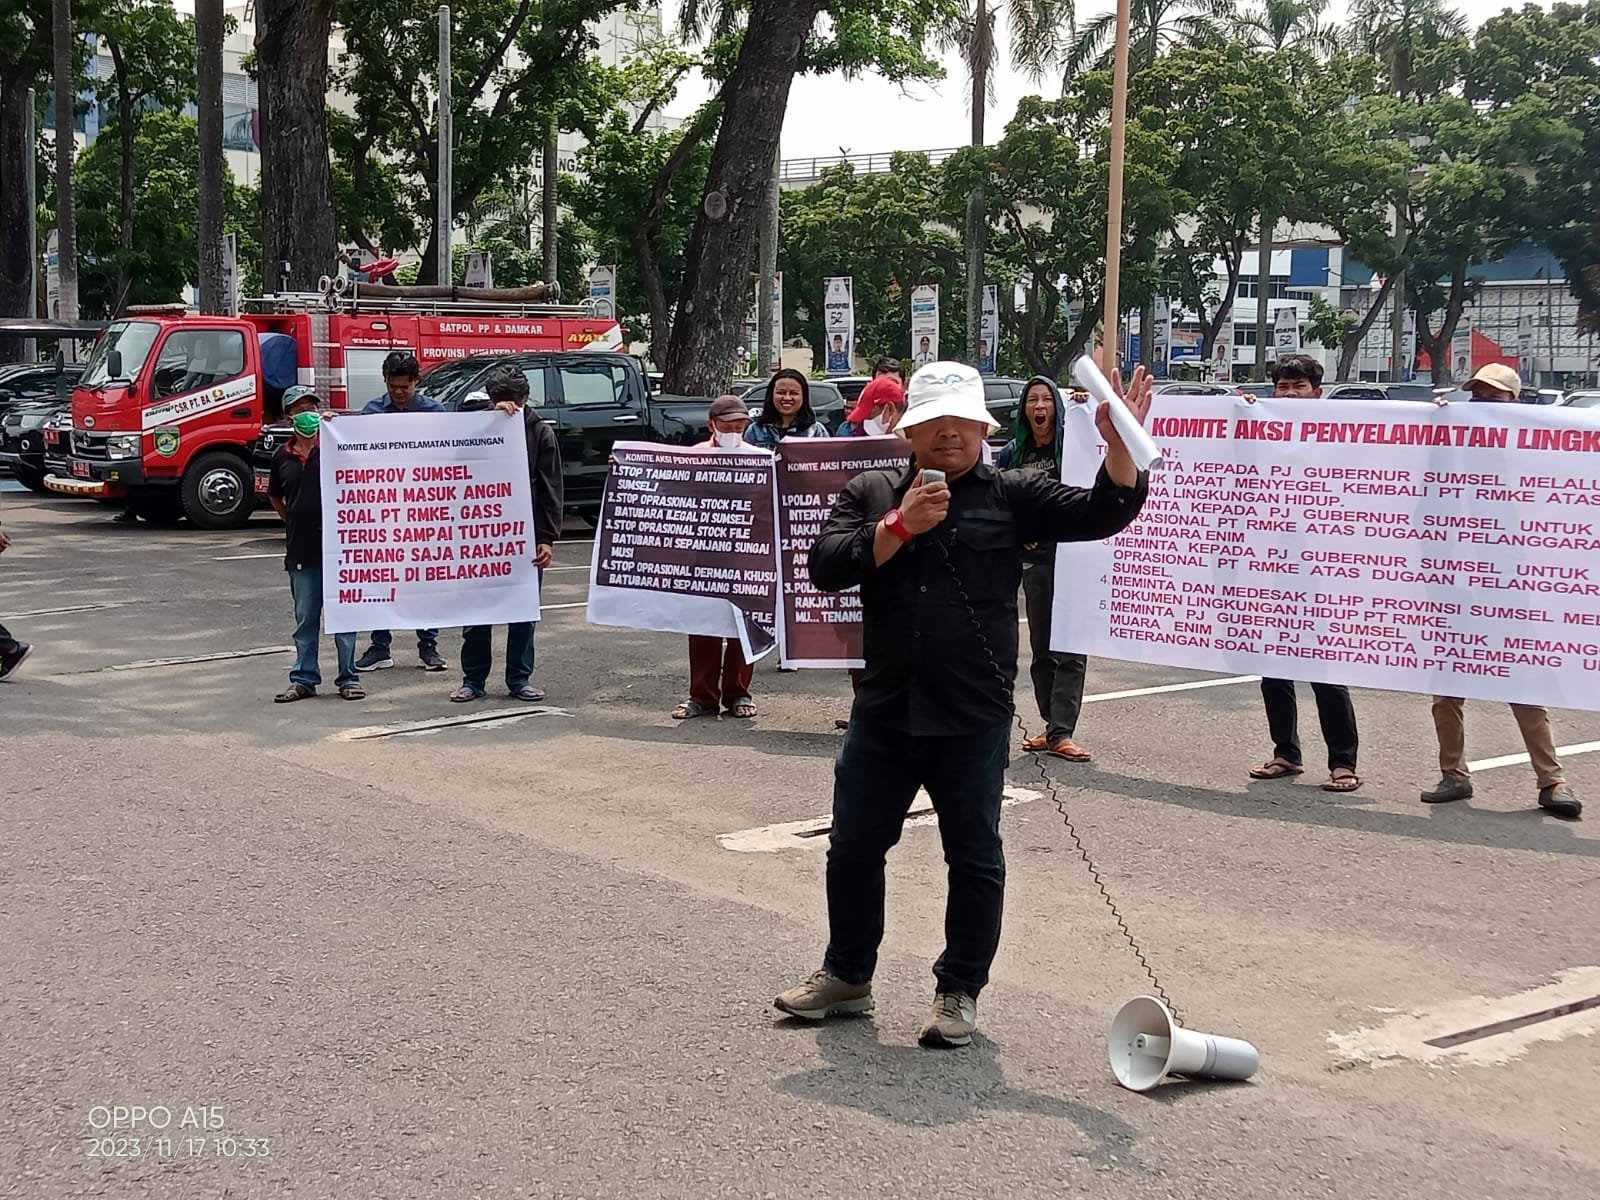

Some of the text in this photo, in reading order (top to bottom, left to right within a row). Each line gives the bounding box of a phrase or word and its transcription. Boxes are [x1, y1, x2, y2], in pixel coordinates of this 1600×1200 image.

[440, 323, 543, 334] SATPOL PP & DAMKAR
[423, 348, 465, 358] PROVINSI
[174, 403, 188, 414] CSR
[190, 398, 200, 409] PT.
[200, 394, 211, 405] BA
[337, 437, 504, 451] KOMITE AKSI PENYELAMATAN LINGKUNGAN
[1152, 417, 1600, 452] KOMITE AKSI PENYELAMATAN LINGK
[625, 453, 734, 466] KOMITE AKSI PENYELAMATAN
[787, 458, 910, 472] KOMITE AKSI PENYELAMATAN
[335, 465, 472, 484] PEMPROV SUMSEL
[646, 468, 690, 481] TAMBANG
[695, 471, 732, 483] BATURA
[734, 473, 755, 483] LIAR
[757, 474, 767, 484] DI
[1193, 462, 1259, 476] KEPADA
[1271, 466, 1291, 477] PJ
[1304, 467, 1410, 482] GUBERNUR
[1424, 472, 1506, 486] SUMSEL
[336, 482, 512, 504] JANGAN MASUK ANGIN
[1173, 488, 1279, 505] LINGKUNGAN
[1285, 494, 1345, 507] HIDUP.
[1175, 475, 1225, 488] DAPAT
[1235, 478, 1332, 493] MENYEGEL
[1343, 483, 1428, 498] KEMBALI
[1439, 487, 1464, 499] PT
[1476, 489, 1535, 503] RMKE
[608, 492, 752, 511] 2.STOP OPRASIONAL STOCK FILE
[337, 504, 502, 524] SOAL PT RMKE, GASS
[615, 506, 710, 522] BATUBARA ILEGAL DI
[1191, 503, 1593, 535] KEPADA PJ GUBERNUR SUMSEL UNTUK
[338, 521, 525, 544] TERUS SAMPAI TUTUP!!
[638, 521, 694, 536] OPRASIONAL
[697, 526, 727, 537] STOCK
[729, 528, 750, 539] FILE
[1147, 526, 1245, 543] MUARA ENIM
[1217, 518, 1239, 529] PT
[1247, 519, 1297, 533] RMKE
[1305, 523, 1356, 536] ATAS
[1365, 527, 1447, 541] DUGAAN
[412, 547, 454, 561] SAJA
[460, 541, 526, 559] RAKJAT
[611, 547, 634, 558] MUSI
[612, 534, 660, 547] BATUBARA
[663, 537, 672, 547] DI
[674, 539, 731, 552] SEPANJANG
[734, 543, 770, 554] SUNGAI
[1113, 549, 1208, 567] OPRASIONAL
[1217, 558, 1239, 570] PT
[1248, 561, 1300, 575] RMKE
[1310, 565, 1360, 579] ATAS
[1372, 569, 1455, 586] DUGAAN
[1114, 536, 1589, 580] MEMINTA KEPADA PJ GUBERNUR SUMSEL UNTUK
[339, 561, 512, 584] SUMSEL DI BELAKANG
[602, 560, 634, 571] 4.STOP
[637, 562, 692, 577] OPRASIONAL
[695, 567, 741, 581] DERMAGA
[1112, 562, 1173, 578] SUMSEL.
[609, 574, 768, 596] BATUBARA DI SEPANJANG SUNGAI
[795, 597, 835, 608] RAKJAT
[1100, 574, 1554, 622] 4. MEMINTA DAN MEDESAK DLHP PROVINSI SUMSEL
[752, 611, 773, 623] FILE
[822, 611, 863, 623] TENANG
[1111, 588, 1452, 629] DOKUMEN LINGKUNGAN HIDUP PT RMKE.
[1099, 600, 1600, 656] 5. MEMINTA PJ GUBERNUR SUMSEL UNTUK MEMANG
[1110, 614, 1562, 668] MUARA ENIM DAN PJ WALIKOTA PALEMBANG
[1110, 626, 1510, 677] KETERANGAN SOAL PENERBITAN IJIN PT RMKE
